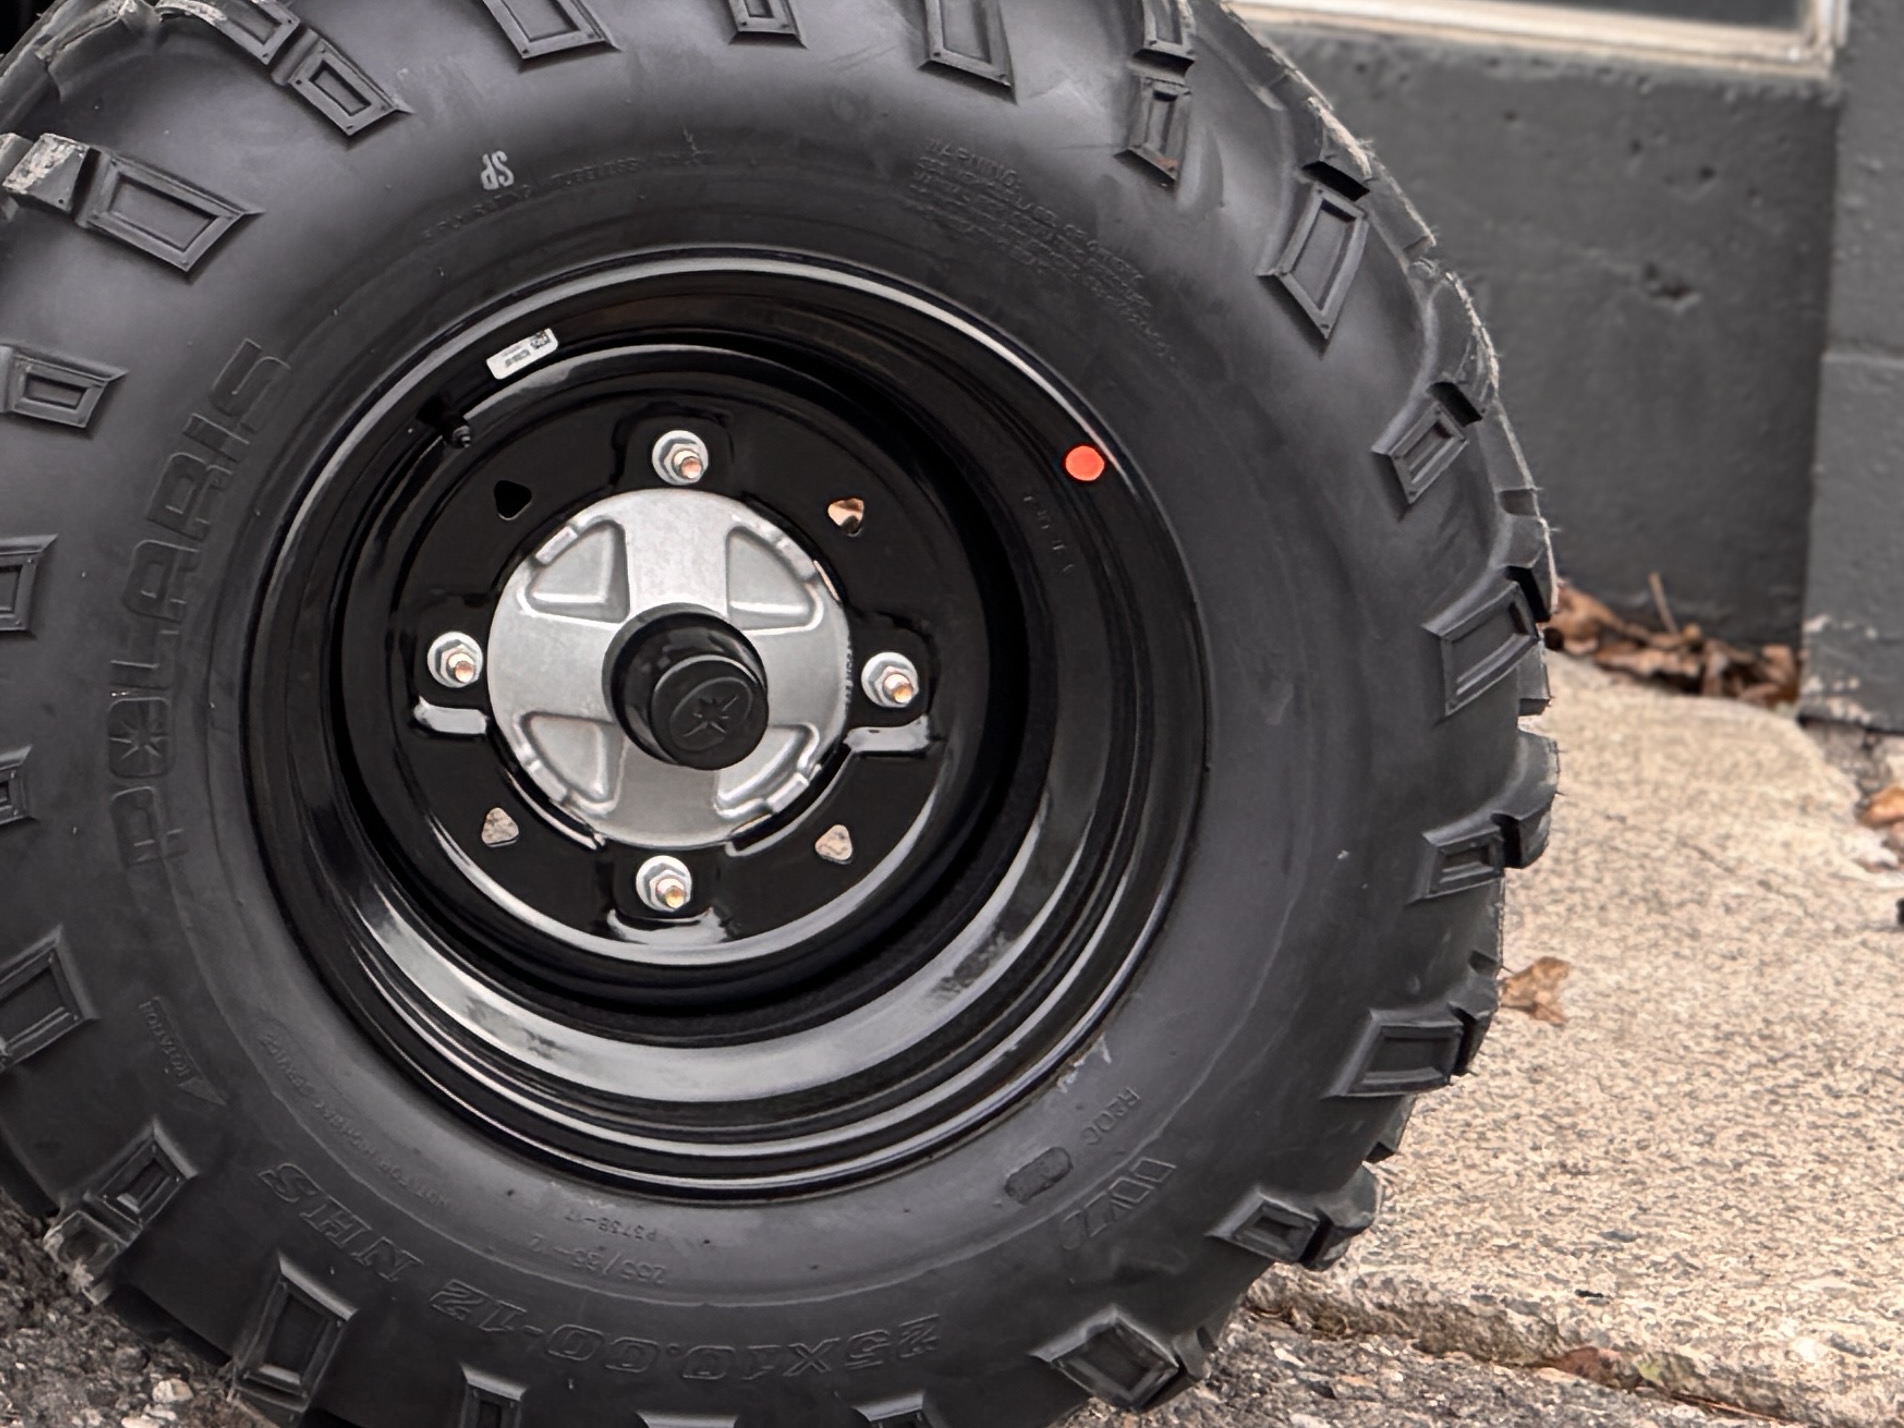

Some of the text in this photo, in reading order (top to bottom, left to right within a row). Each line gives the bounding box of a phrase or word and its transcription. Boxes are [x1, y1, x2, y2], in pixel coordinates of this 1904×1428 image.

[479, 149, 515, 192] SP
[107, 337, 293, 866] POLARIS
[256, 1160, 426, 1284] NHS
